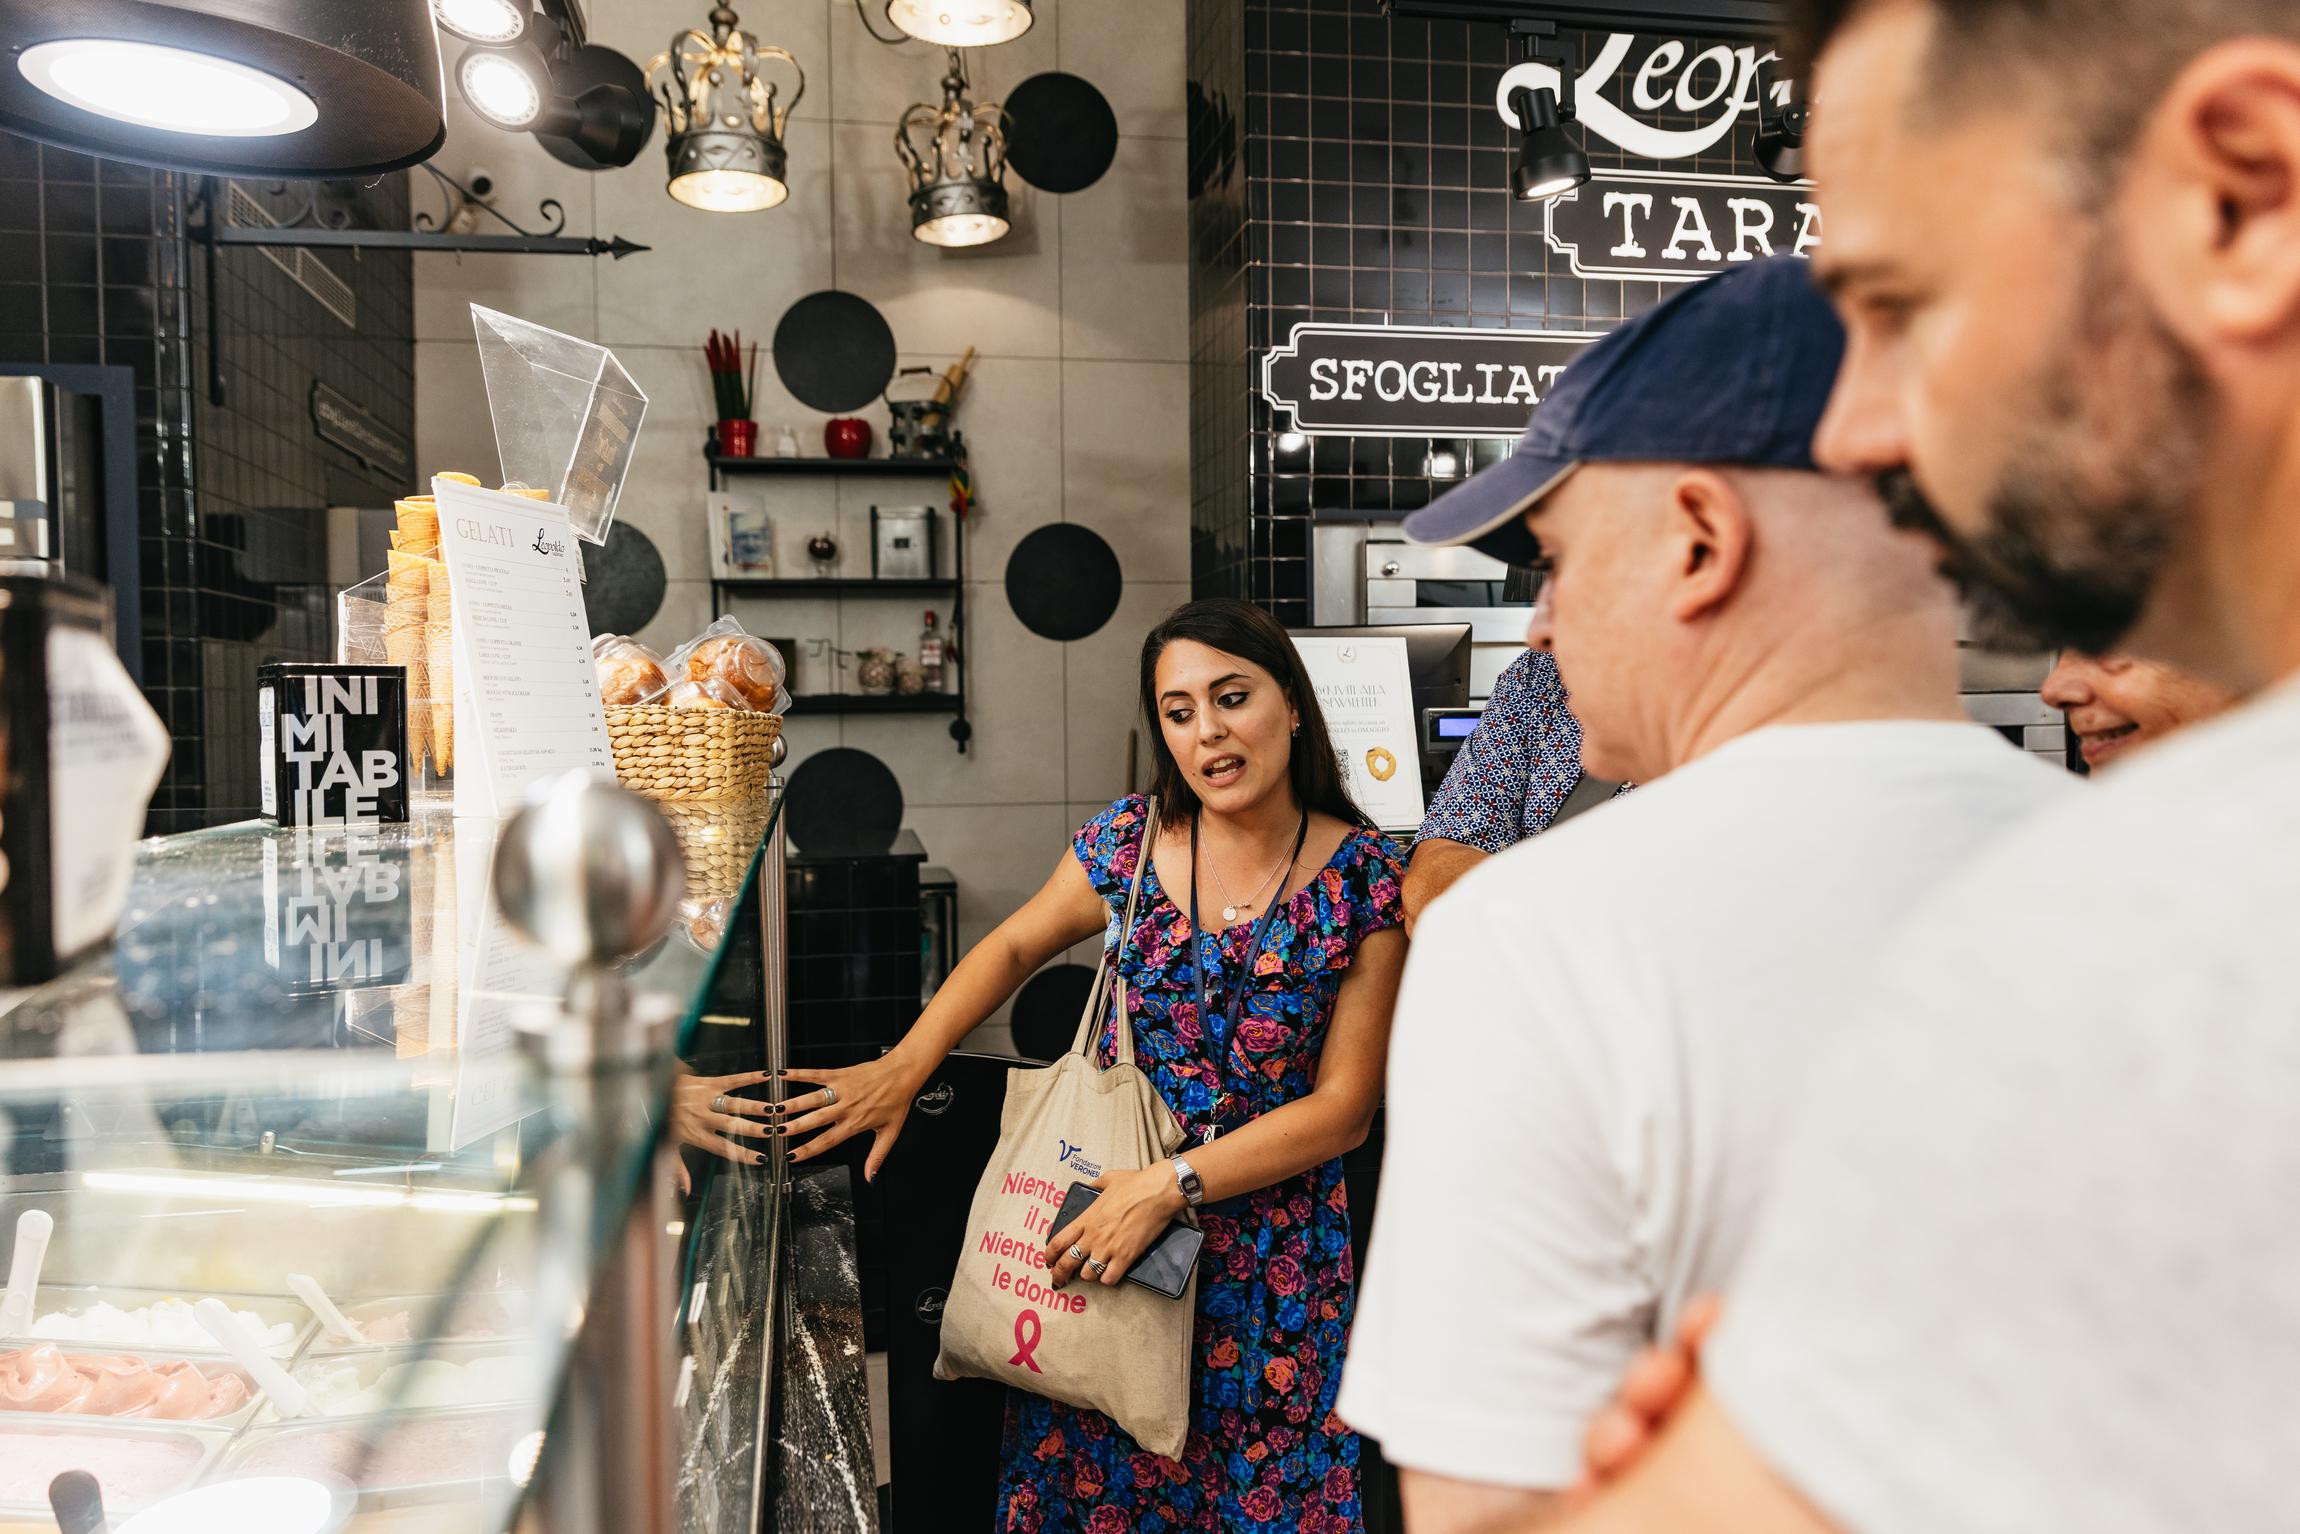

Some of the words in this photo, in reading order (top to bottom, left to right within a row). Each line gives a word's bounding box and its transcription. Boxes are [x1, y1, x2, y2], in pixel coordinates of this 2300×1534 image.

[1497, 33, 1793, 158] Leop
[457, 518, 514, 548] GELATI
[532, 528, 565, 555] Leopoldo
[305, 676, 378, 714] INI
[281, 713, 344, 753] MI
[286, 750, 399, 790] TAB
[295, 788, 379, 827] ILE
[1001, 1171, 1066, 1208] Niente
[1024, 1205, 1039, 1230] il
[979, 1231, 1047, 1269] Niente
[992, 1264, 1011, 1290] le
[1015, 1275, 1087, 1313] donne
